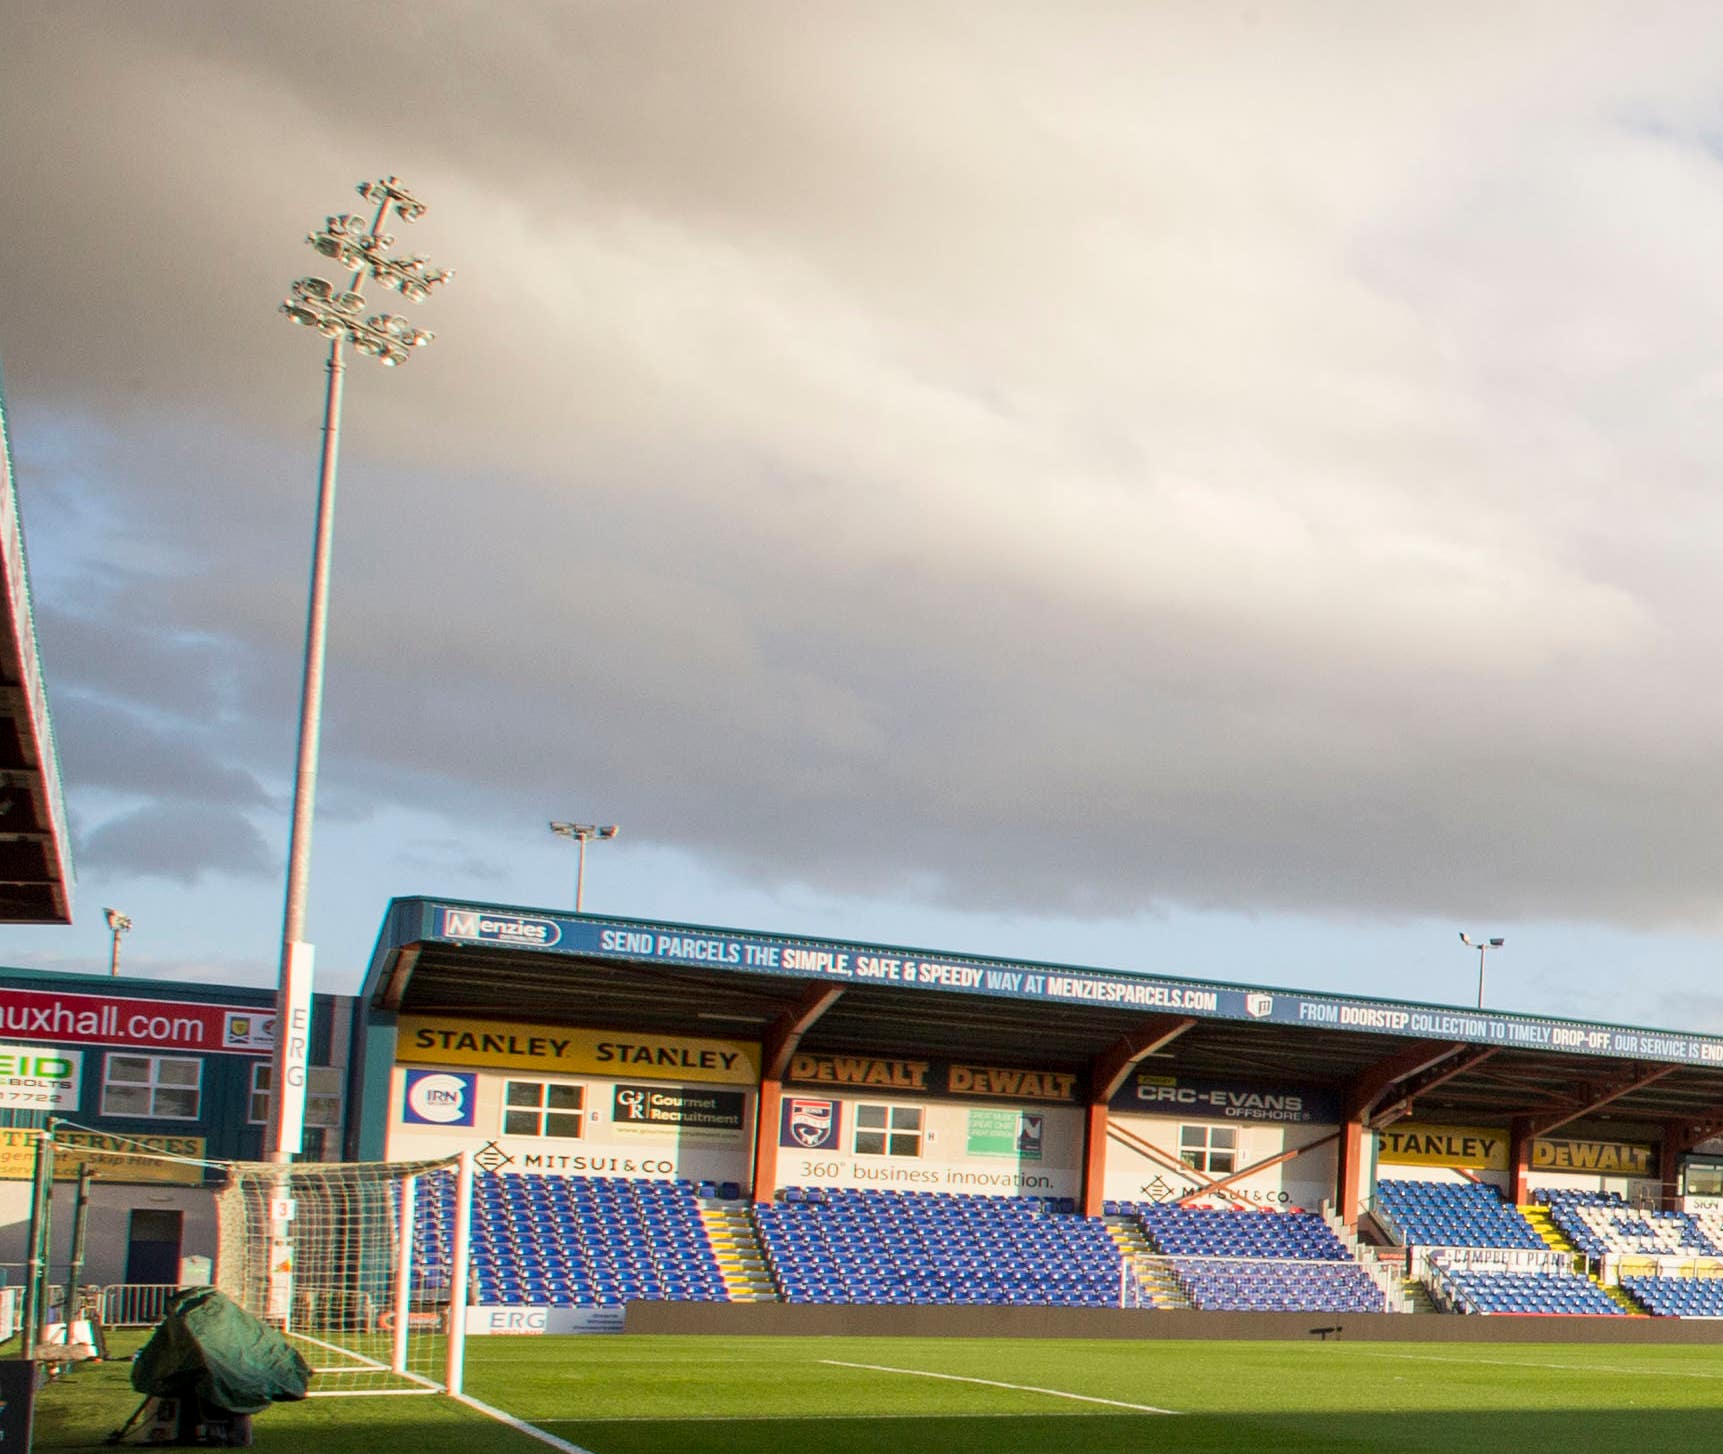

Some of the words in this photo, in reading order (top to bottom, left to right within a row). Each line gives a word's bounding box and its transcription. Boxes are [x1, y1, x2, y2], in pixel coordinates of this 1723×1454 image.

[448, 912, 547, 938] Menzies
[602, 930, 652, 955] SEND
[657, 934, 740, 964] PARCELS
[744, 945, 780, 968] THE
[783, 949, 852, 978] SIMPLE,
[857, 955, 899, 980] SAFE
[905, 961, 916, 981] &
[919, 963, 982, 988] SPEEDY
[986, 973, 1021, 992] WAY
[1024, 975, 1044, 994] AT
[1048, 977, 1216, 1012] MENZIESPARCELS.COM
[0, 1002, 203, 1041] uxhall.com
[1300, 1002, 1338, 1022] FROM
[1340, 1007, 1408, 1029] DOORSTEP
[1411, 1014, 1486, 1036] COLLECTION
[1489, 1022, 1504, 1038] TO
[1508, 1023, 1550, 1042] TIMELY
[1615, 1035, 1637, 1050] OUR
[1640, 1039, 1686, 1057] SERVICE
[1688, 1043, 1699, 1057] IS
[288, 1009, 306, 1087] ERG
[417, 1029, 571, 1058] STANLEY
[596, 1043, 738, 1071] STANLEY
[652, 1093, 717, 1110] Gourmet
[1138, 1086, 1302, 1111] CRC-EVANS
[652, 1107, 738, 1125] Recruitment
[54, 1131, 196, 1154] SERVICES
[1379, 1132, 1497, 1158] STANLEY
[525, 1154, 616, 1172] MITSUI
[625, 1159, 636, 1172] &
[642, 1160, 678, 1174] CO.
[854, 1163, 939, 1184] business
[948, 1169, 1054, 1189] innovation.
[1267, 1192, 1293, 1203] CO.
[489, 1312, 545, 1329] ERG
